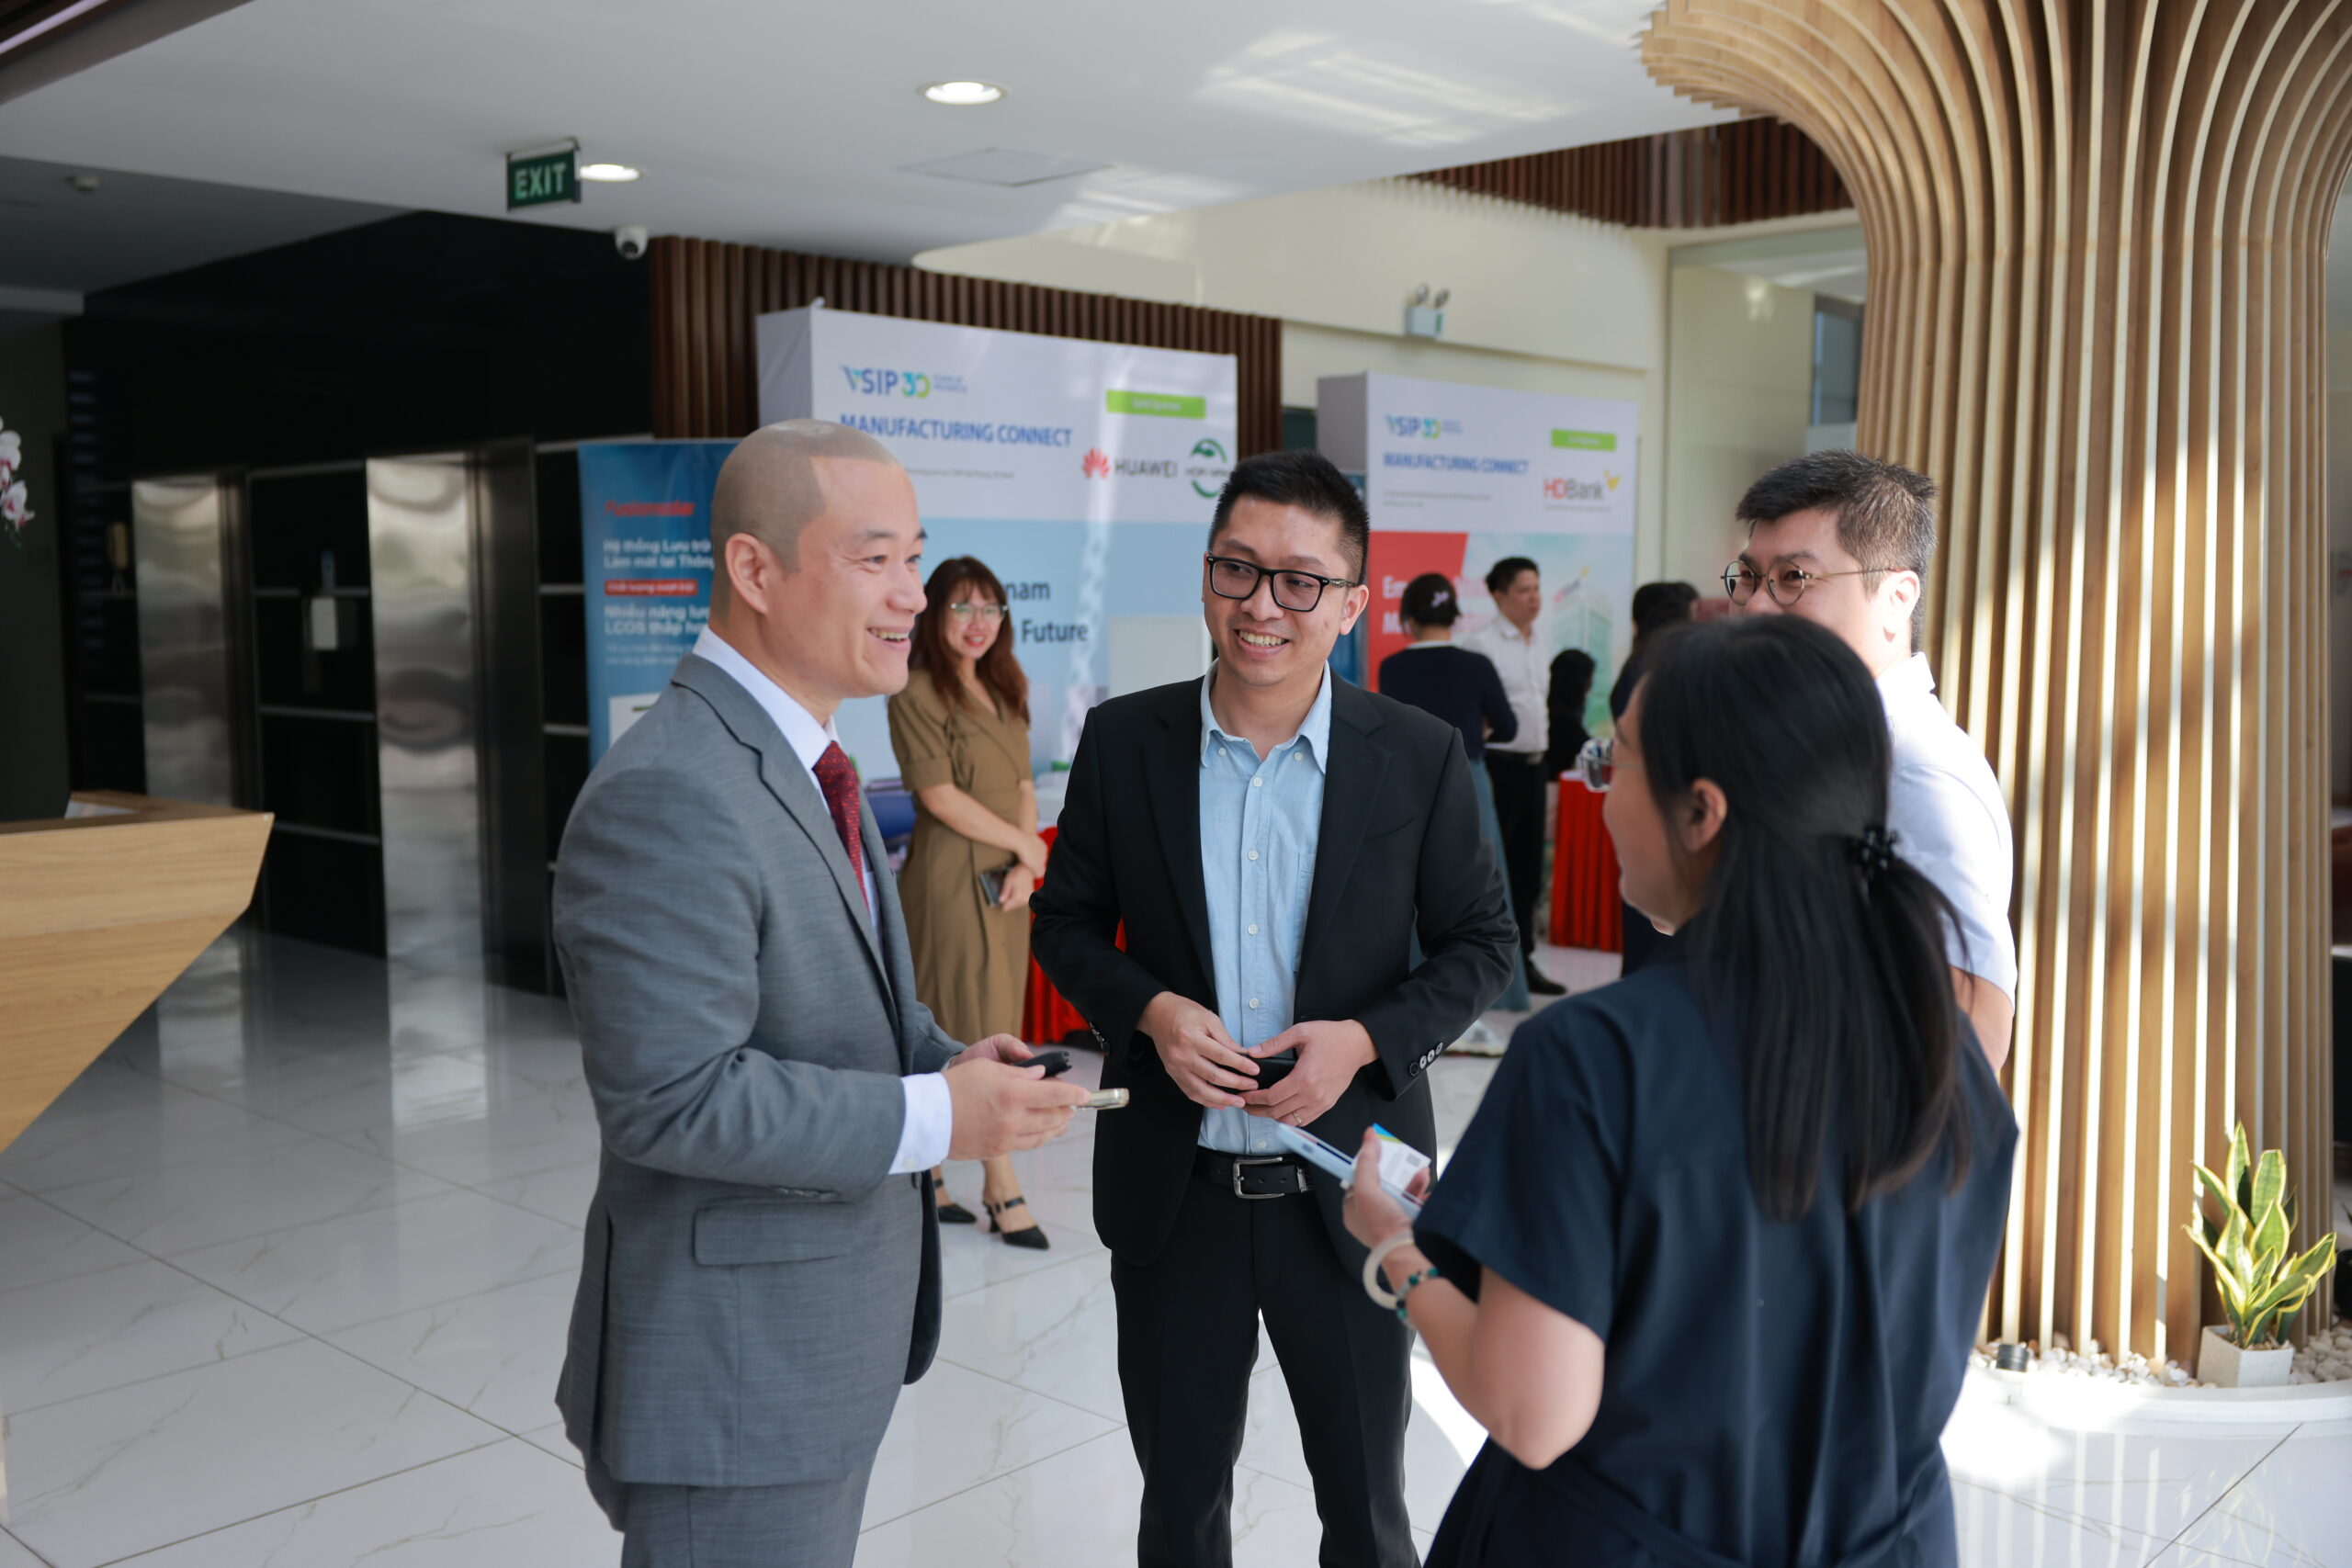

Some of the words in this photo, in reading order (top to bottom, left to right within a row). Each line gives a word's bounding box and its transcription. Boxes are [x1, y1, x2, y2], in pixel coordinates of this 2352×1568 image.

[514, 162, 567, 200] EXIT
[840, 412, 993, 443] MANUFACTURING
[997, 423, 1072, 447] CONNECT
[1114, 460, 1178, 479] HUAWEI
[1384, 452, 1479, 473] MANUFACTURING
[1481, 457, 1530, 475] CONNECT
[1544, 478, 1605, 501] HDBank
[1022, 620, 1088, 642] Future
